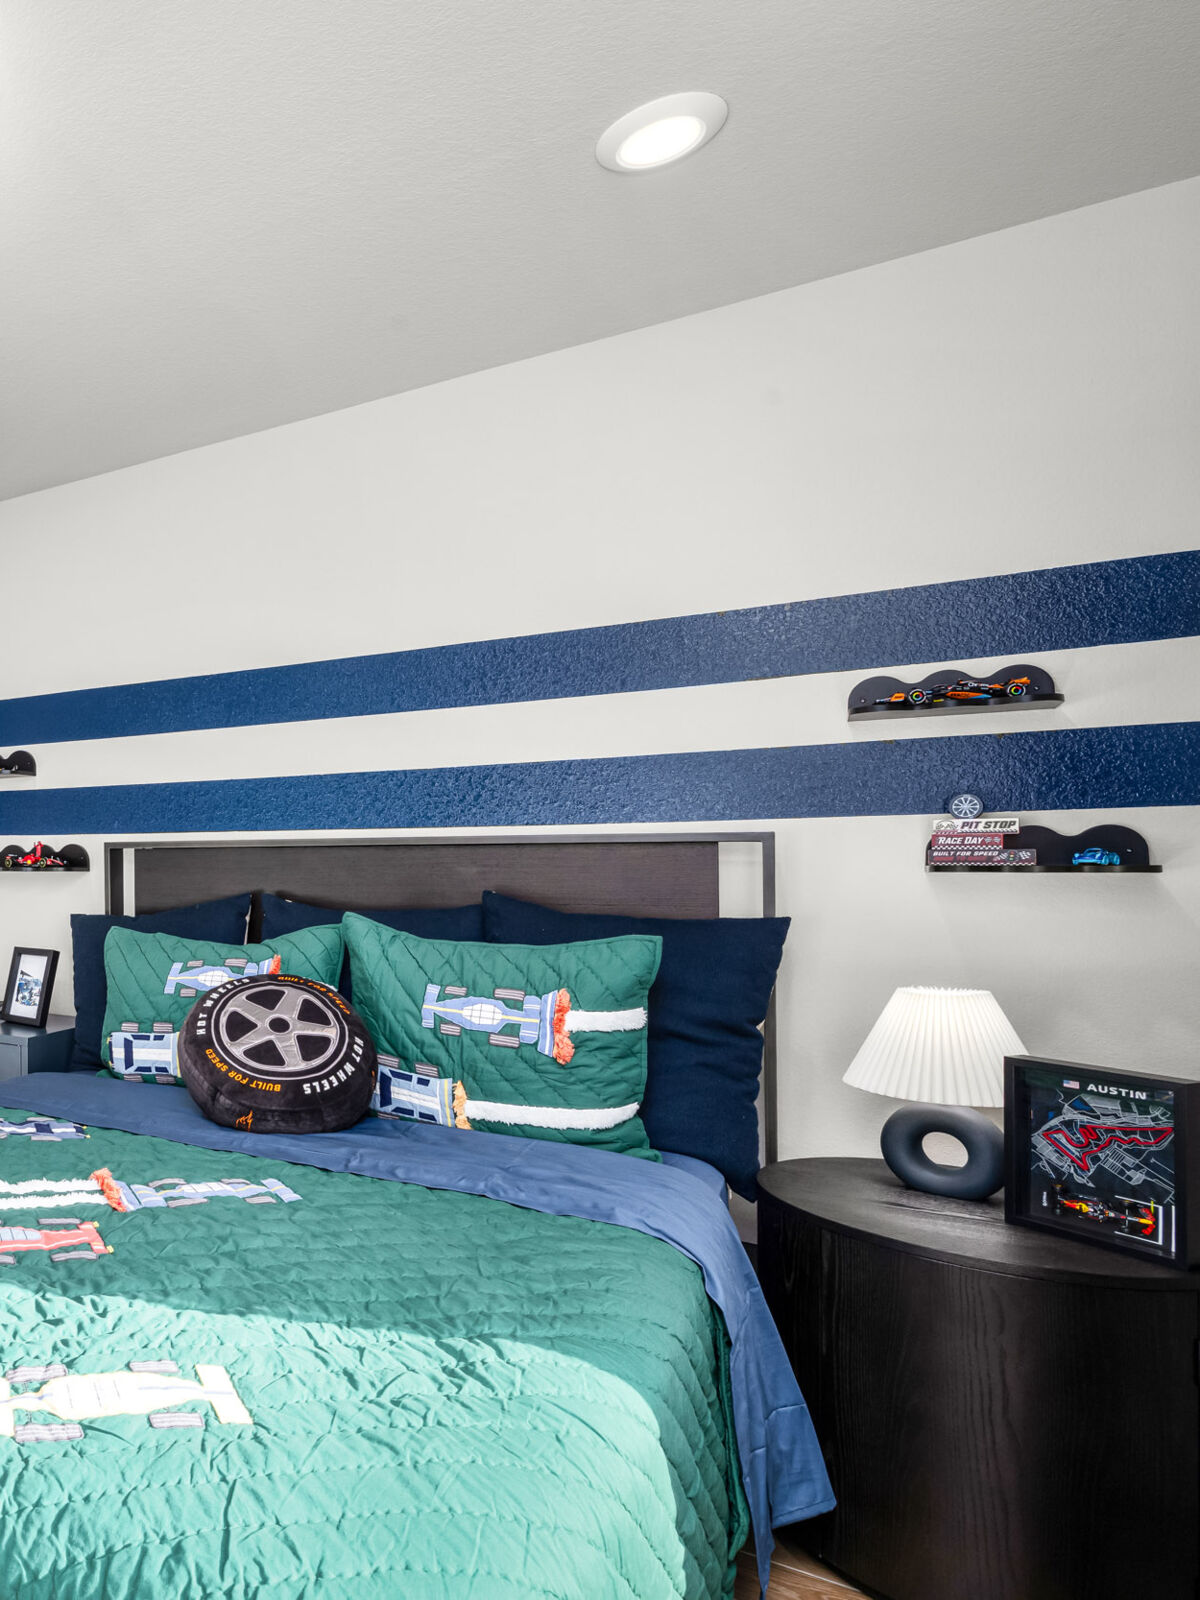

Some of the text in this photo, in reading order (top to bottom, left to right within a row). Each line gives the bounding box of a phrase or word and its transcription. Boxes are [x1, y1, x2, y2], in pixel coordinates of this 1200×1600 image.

[960, 820, 1017, 829] PIT STOP
[938, 836, 984, 845] RACE DAY
[196, 978, 251, 1035] HOT WHEELS
[205, 1048, 282, 1092] BUILT FOR SPEED
[302, 1036, 364, 1095] HOT WHEELS
[1086, 1083, 1147, 1100] AUSTIN
